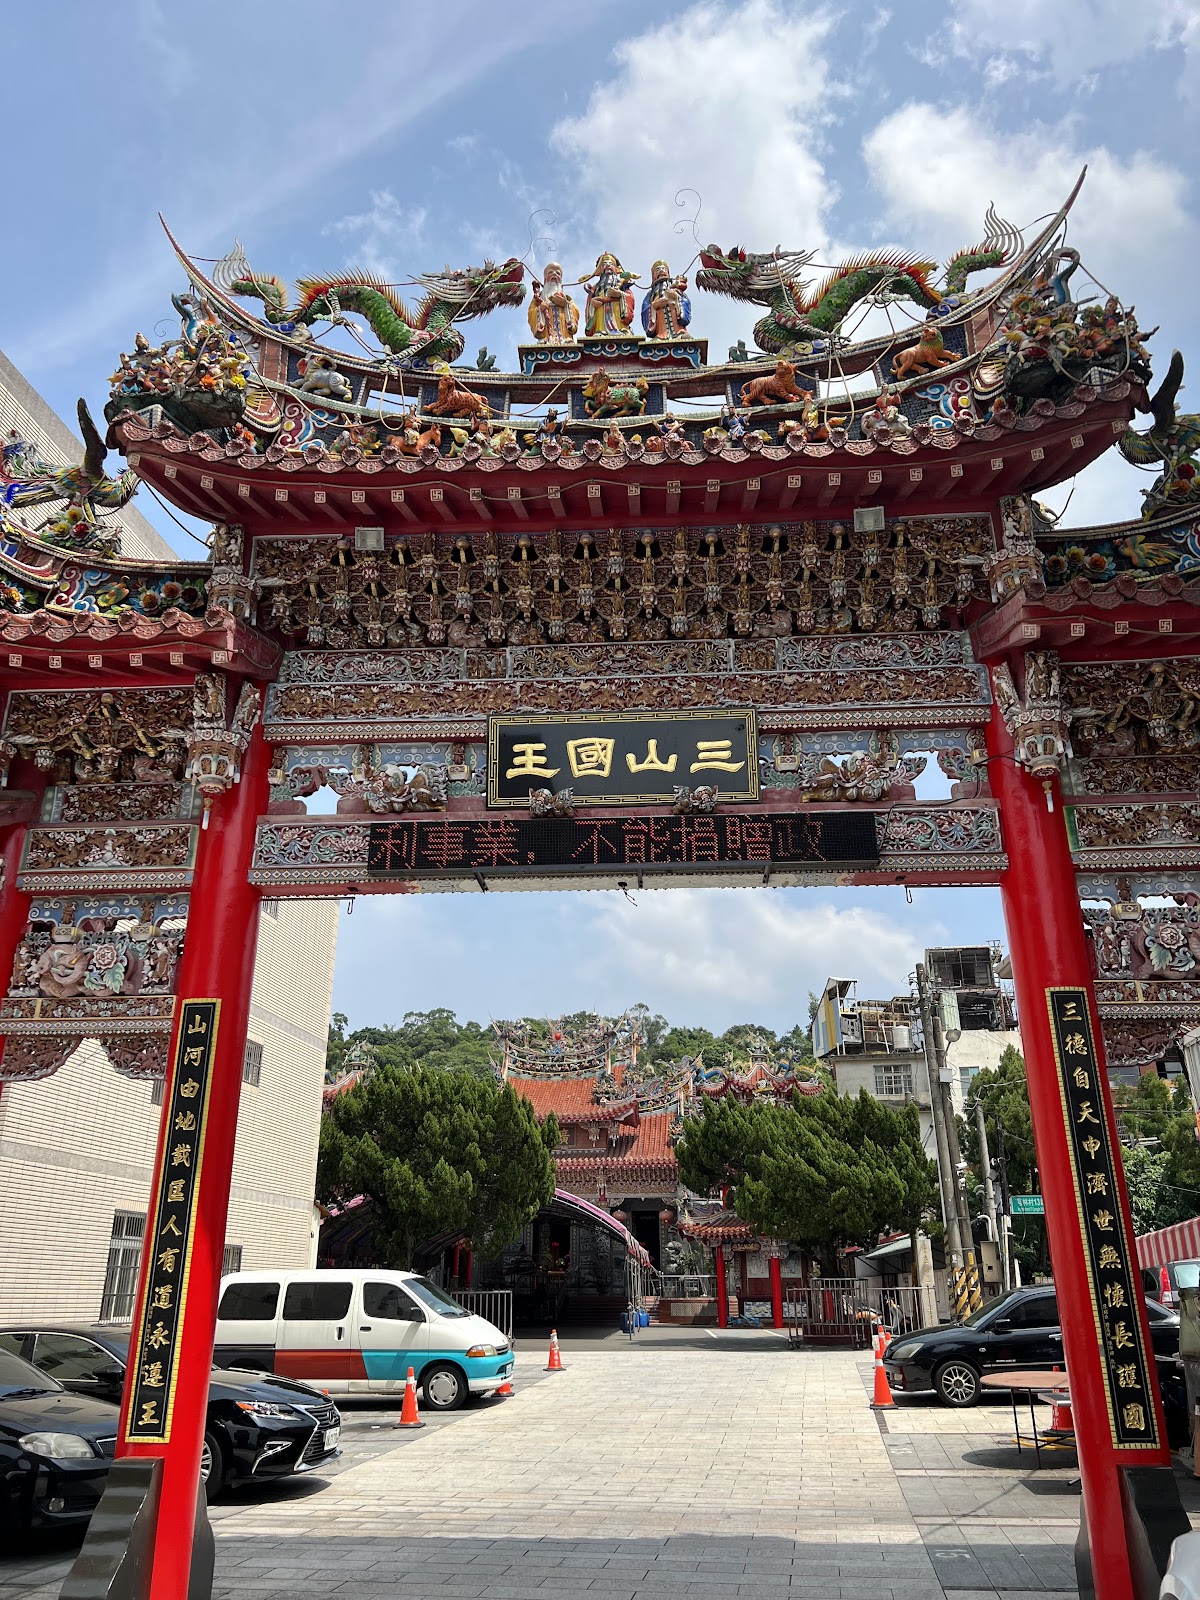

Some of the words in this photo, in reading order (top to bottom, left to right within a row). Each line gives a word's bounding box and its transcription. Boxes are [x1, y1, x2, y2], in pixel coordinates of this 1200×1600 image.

[505, 737, 745, 779] 三山國王
[934, 1549, 971, 1559] 15
